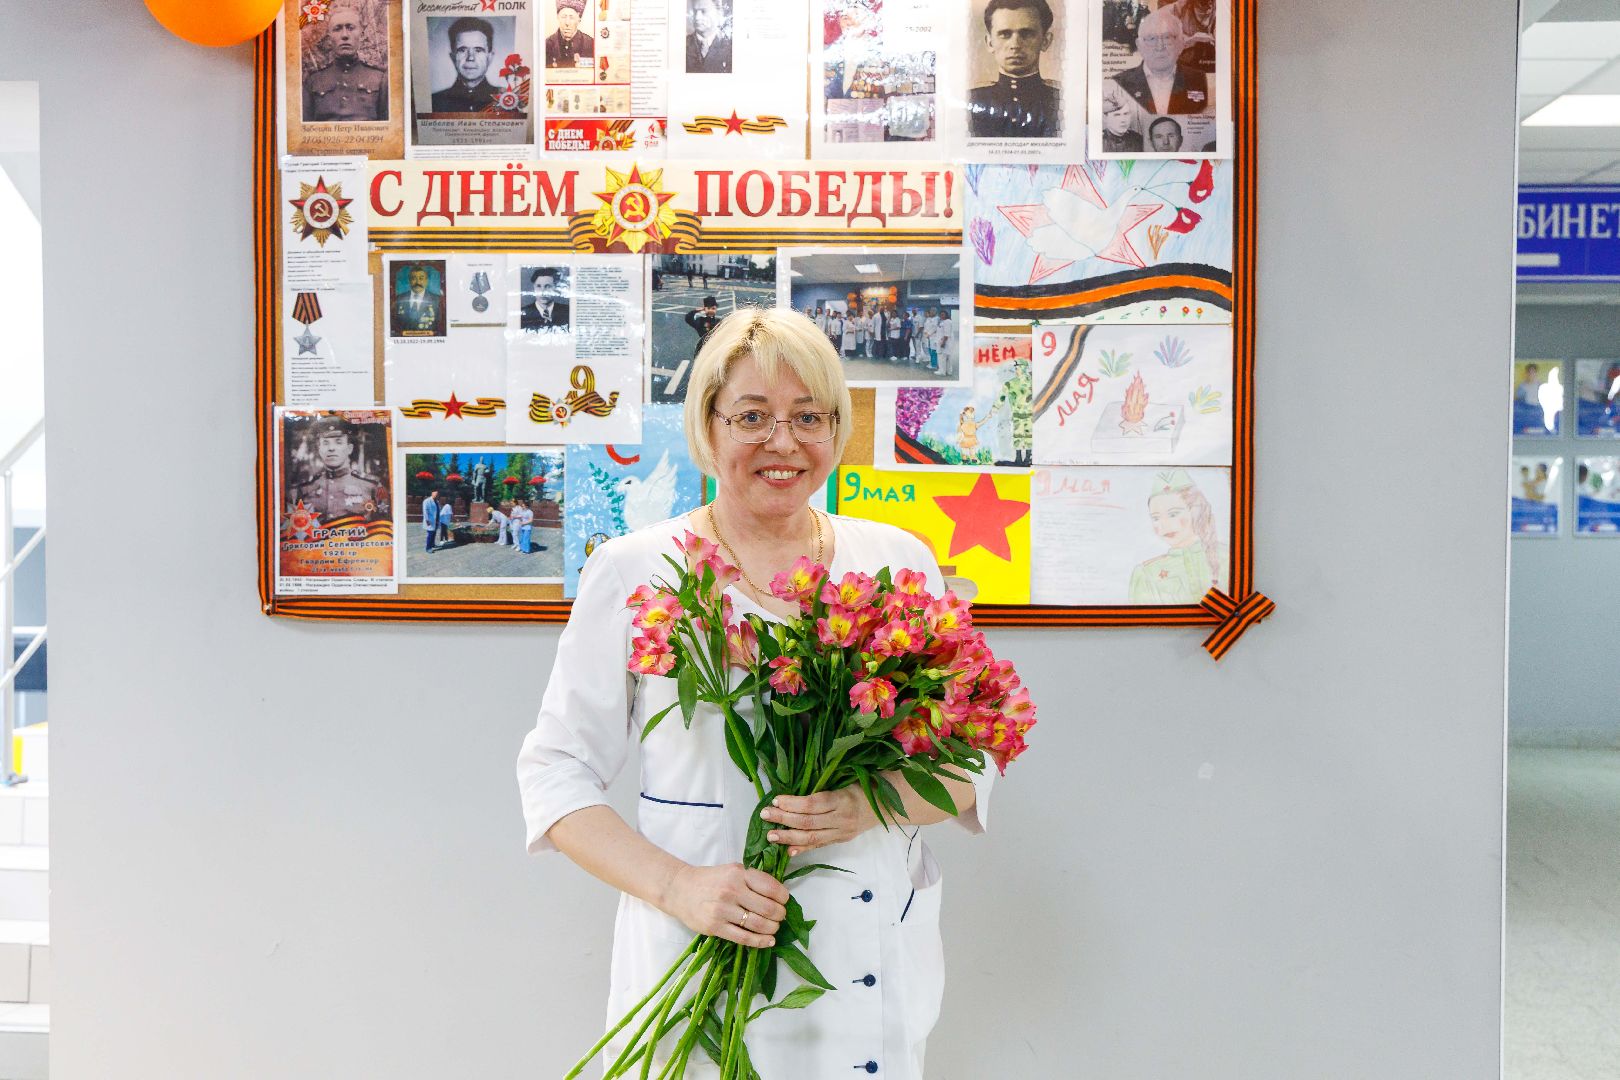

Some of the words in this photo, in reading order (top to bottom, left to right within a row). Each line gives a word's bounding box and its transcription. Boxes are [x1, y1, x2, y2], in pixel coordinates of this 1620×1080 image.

[548, 129, 555, 139] С
[557, 129, 584, 141] ДНЕМ
[548, 140, 591, 150] ПОБЕДЫ!
[369, 169, 405, 217] С
[416, 163, 579, 227] ДНЁМ
[694, 169, 955, 228] ПОБЕДЫ!
[1041, 331, 1056, 356] 9
[1036, 470, 1051, 496] 9
[313, 527, 367, 537] ГРАТИЙ
